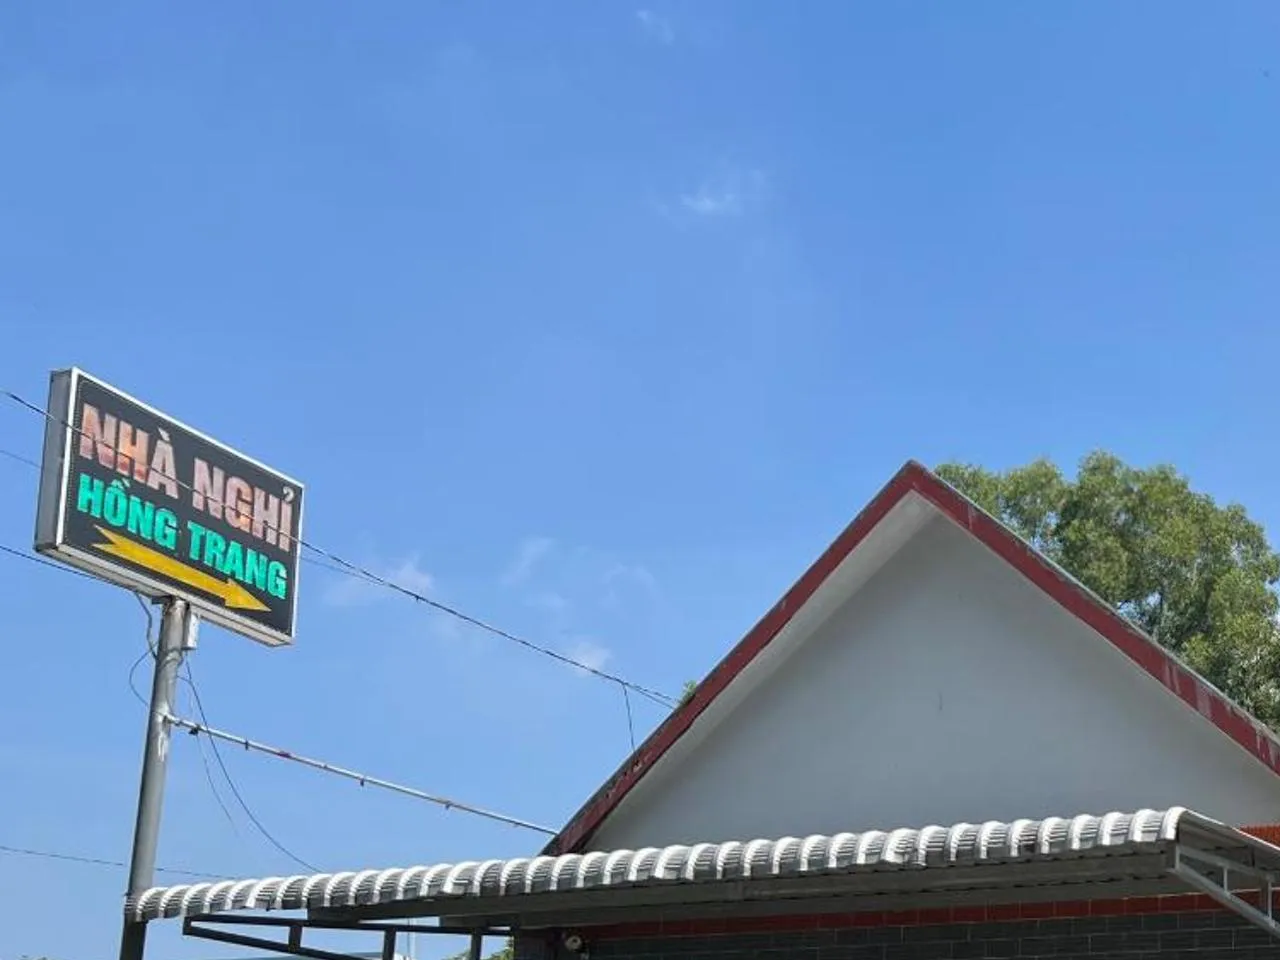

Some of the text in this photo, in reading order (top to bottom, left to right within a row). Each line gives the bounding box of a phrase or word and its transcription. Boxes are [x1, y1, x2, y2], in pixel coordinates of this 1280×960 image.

[77, 473, 289, 600] HỒNG TRANG
[79, 403, 295, 552] NHÀ NGHỈ
